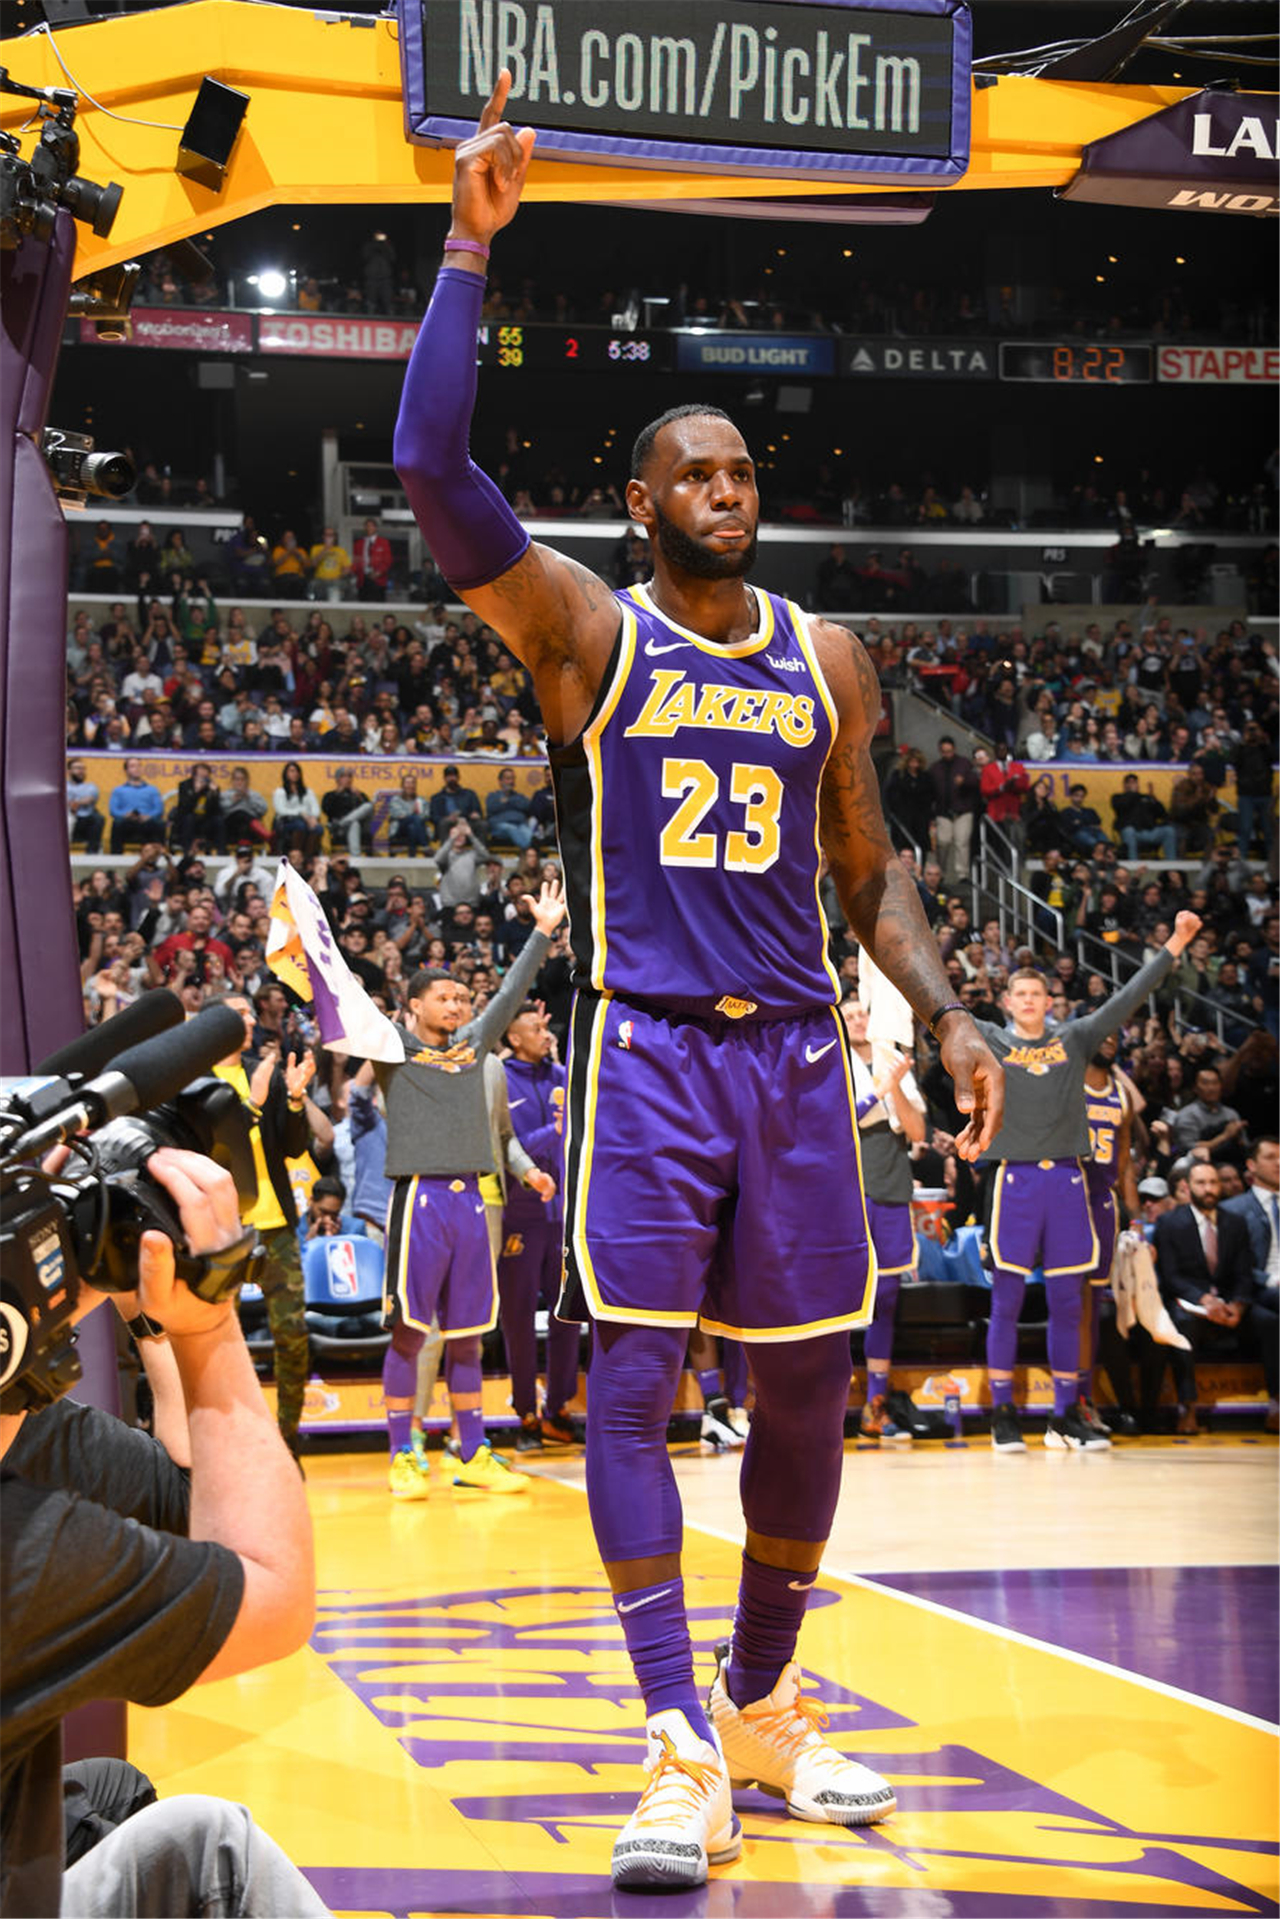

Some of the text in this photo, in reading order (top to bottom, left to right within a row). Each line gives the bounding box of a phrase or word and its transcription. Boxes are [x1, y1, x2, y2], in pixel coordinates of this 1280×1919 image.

[459, 0, 921, 134] NBA.com/PickEm
[1192, 113, 1280, 159] LA
[263, 321, 417, 353] TOSHIBA
[565, 338, 578, 357] 2
[608, 340, 651, 361] 5:38
[702, 346, 809, 366] BUD LIGHT
[884, 349, 988, 371] DELTA
[1053, 348, 1125, 381] 8:22
[765, 653, 806, 672] wish
[623, 669, 817, 748] LAKERS
[660, 757, 785, 874] 23
